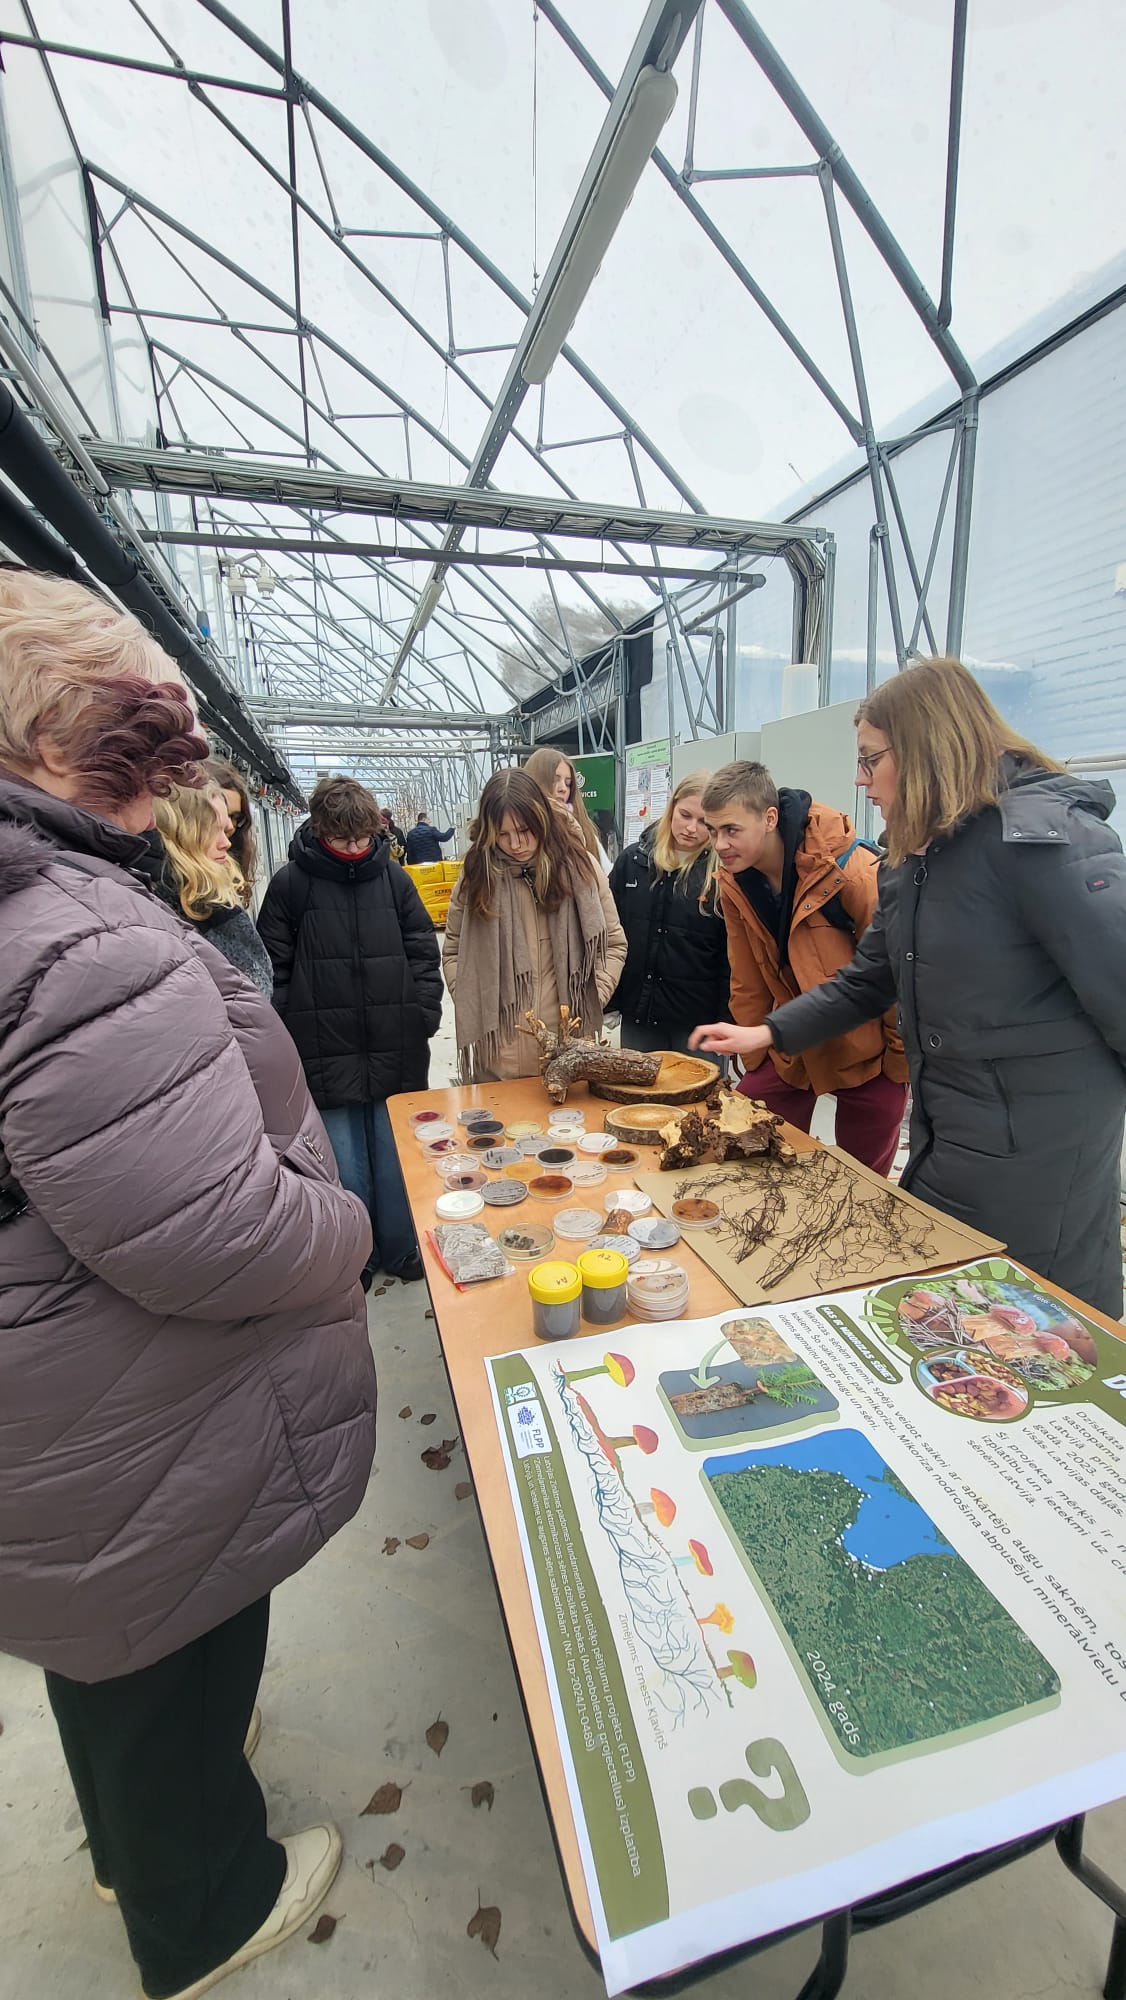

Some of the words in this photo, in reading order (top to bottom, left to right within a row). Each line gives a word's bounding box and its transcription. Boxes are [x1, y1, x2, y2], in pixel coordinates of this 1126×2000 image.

[581, 790, 597, 798] VICES
[822, 1307, 838, 1324] KAS
[817, 1359, 836, 1383] starp
[834, 1379, 852, 1397] augu
[850, 1398, 862, 1410] un
[860, 1410, 878, 1431] sēni.
[531, 1428, 545, 1449] FLPP
[1033, 1424, 1062, 1448] gadā.
[1066, 1451, 1097, 1477] 2023.
[1049, 1419, 1085, 1450] Latvijā
[1062, 1415, 1121, 1463] sastopama
[803, 1309, 830, 1336] Mikorizas
[829, 1336, 851, 1359] sēnēm
[873, 1386, 894, 1409] spēja
[895, 1410, 922, 1439] veidot
[921, 1441, 951, 1474] saikni
[949, 1471, 961, 1484] ar
[961, 1485, 1011, 1535] apkārtējo
[1012, 1538, 1043, 1570] augu
[1045, 1574, 1097, 1635] saknēm,
[966, 1438, 1000, 1470] sēnēm
[998, 1469, 1036, 1507] Latvijā.
[981, 1434, 1025, 1475] izplatību
[1026, 1476, 1043, 1492] un
[1043, 1495, 1090, 1537] ietekmi
[1090, 1539, 1109, 1555] uz
[1007, 1445, 1053, 1486] projekta
[1055, 1489, 1097, 1525] mērķis
[1100, 1528, 1115, 1539] ir
[1021, 1426, 1048, 1450] visās
[1047, 1450, 1090, 1489] Latvijas
[1089, 1488, 1125, 1518] daļās.
[537, 1525, 550, 1557] augsnes
[545, 1509, 563, 1559] ektomikorizas
[819, 1342, 838, 1364] saikni
[837, 1363, 853, 1381] sauc
[851, 1380, 866, 1396] par
[864, 1395, 897, 1434] mikorizu.
[897, 1434, 933, 1474] Mikoriza
[932, 1473, 982, 1529] nodrošina
[981, 1530, 1035, 1584] abpusēju
[1034, 1585, 1121, 1686] minerālvielu
[559, 1558, 569, 1585] sēnes
[543, 1455, 555, 1480] Latvijas
[556, 1508, 572, 1543] padomes
[566, 1541, 586, 1599] fundamentālo
[584, 1612, 598, 1647] lietišķo
[591, 1647, 611, 1692] pētījumu
[603, 1693, 623, 1741] projekts
[617, 1742, 636, 1783] (FLPP)
[573, 1625, 586, 1654] bekas
[579, 1654, 605, 1730] (Aureoboletus
[634, 1665, 653, 1707] Ernests
[806, 1650, 837, 1698] 2024.
[828, 1700, 861, 1745] gads
[598, 1731, 627, 1812] projectellus)
[619, 1812, 641, 1877] izplatība
